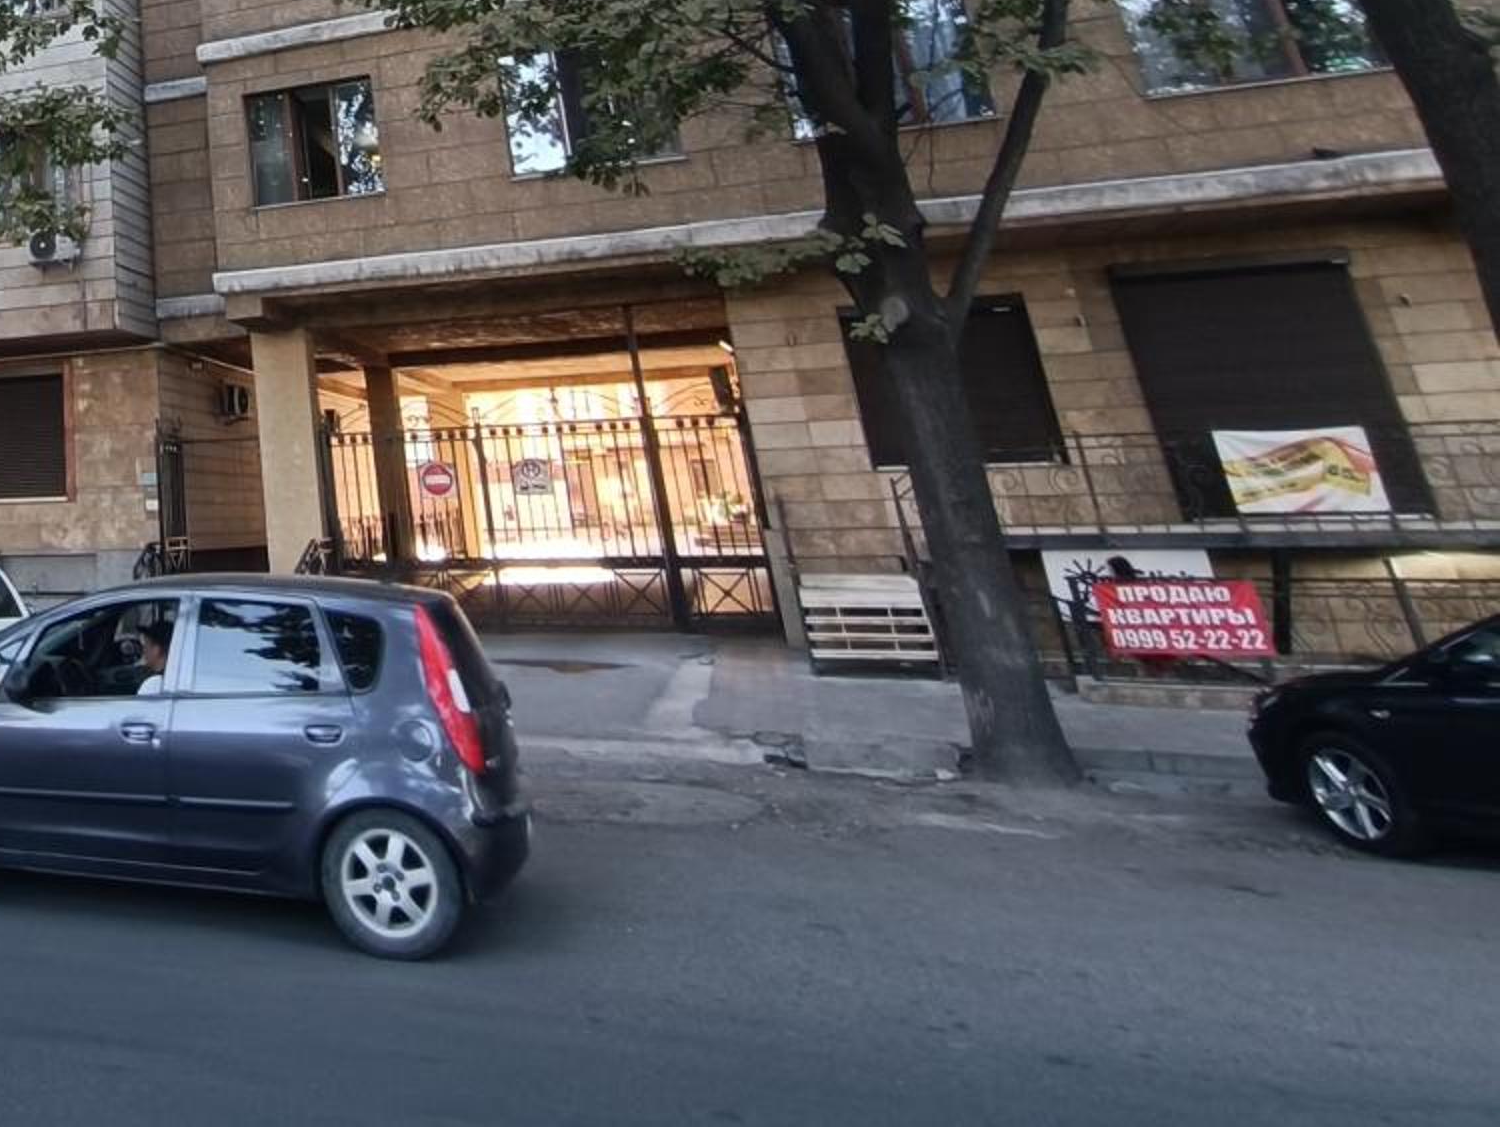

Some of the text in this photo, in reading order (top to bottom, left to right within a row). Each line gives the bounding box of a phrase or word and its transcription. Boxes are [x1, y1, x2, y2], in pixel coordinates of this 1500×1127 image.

[1116, 585, 1231, 605] ПРОДАЮ
[1107, 607, 1257, 626] КВАРТИРЫ
[1112, 628, 1268, 650] 0999 52-22-22
